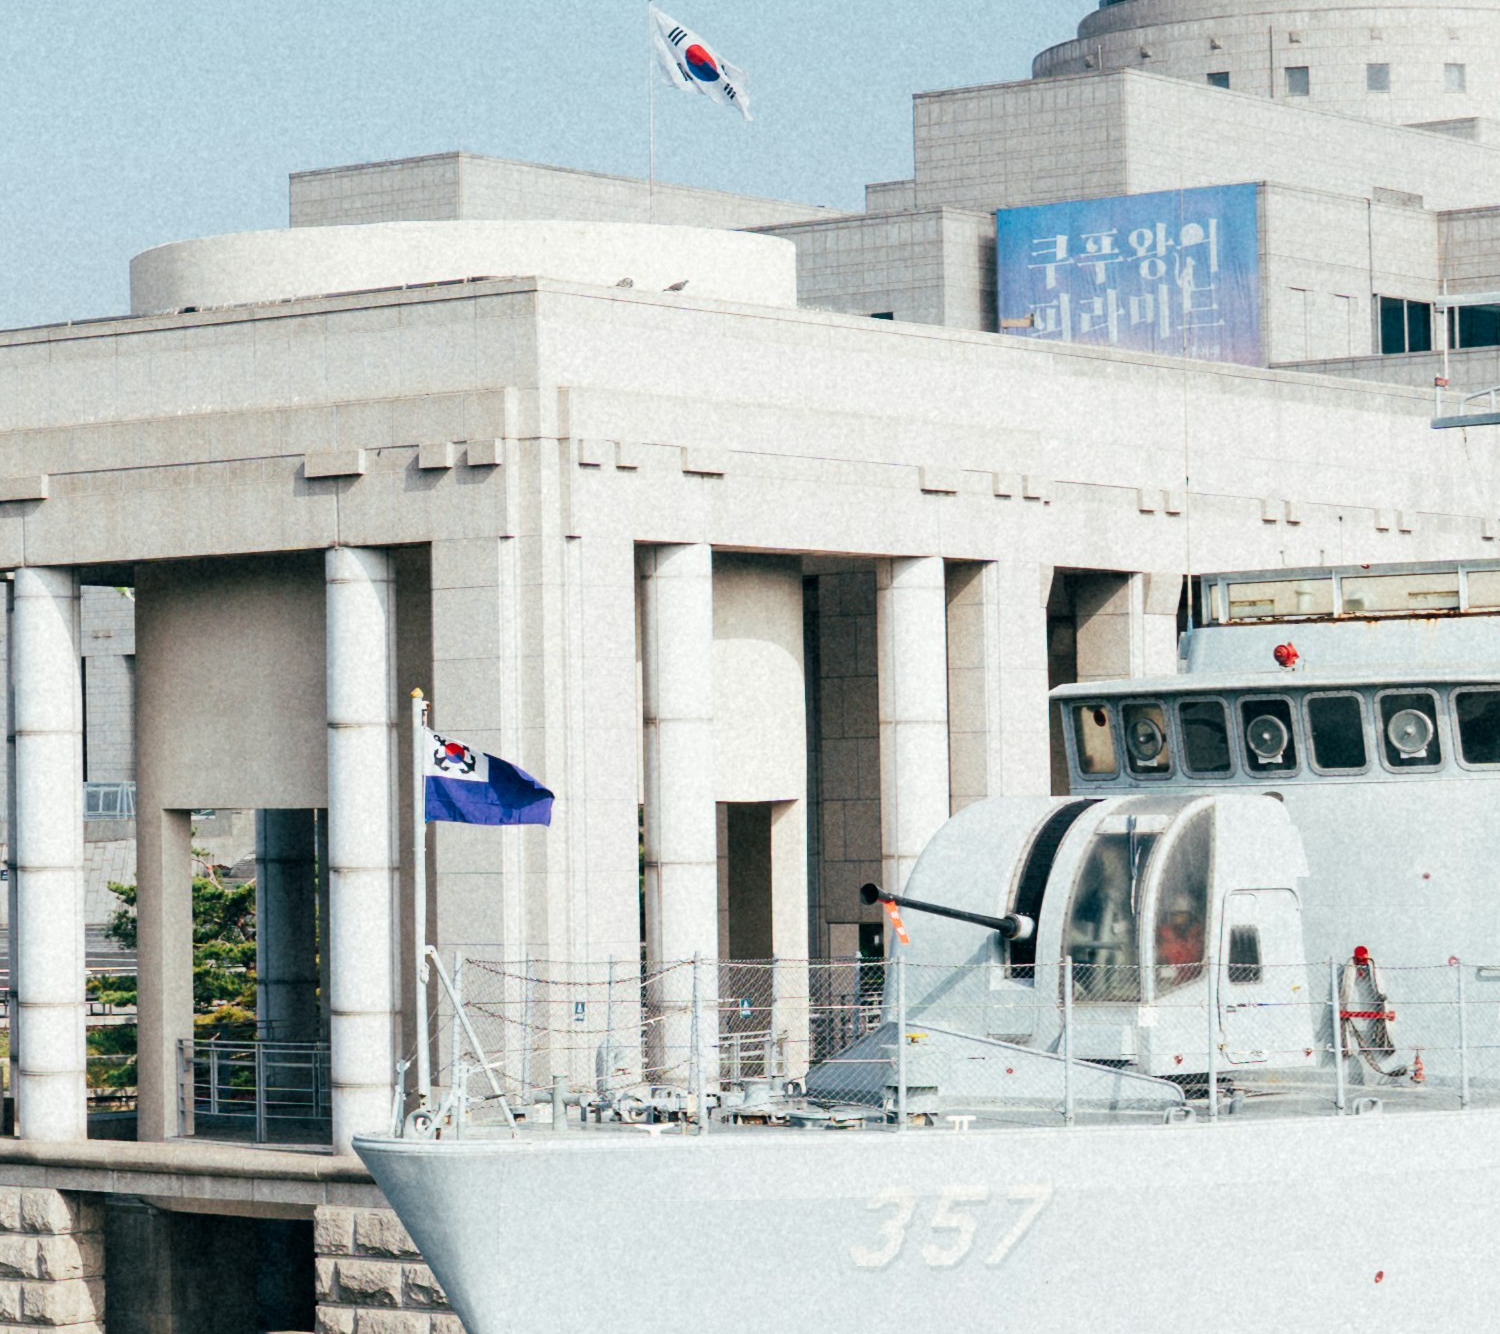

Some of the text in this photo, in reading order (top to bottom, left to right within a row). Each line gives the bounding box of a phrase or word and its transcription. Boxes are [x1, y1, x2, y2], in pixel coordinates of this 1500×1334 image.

[1027, 218, 1219, 290] 쿠푸왕의
[1028, 281, 1225, 343] 피라미드
[849, 1182, 1053, 1271] 357
